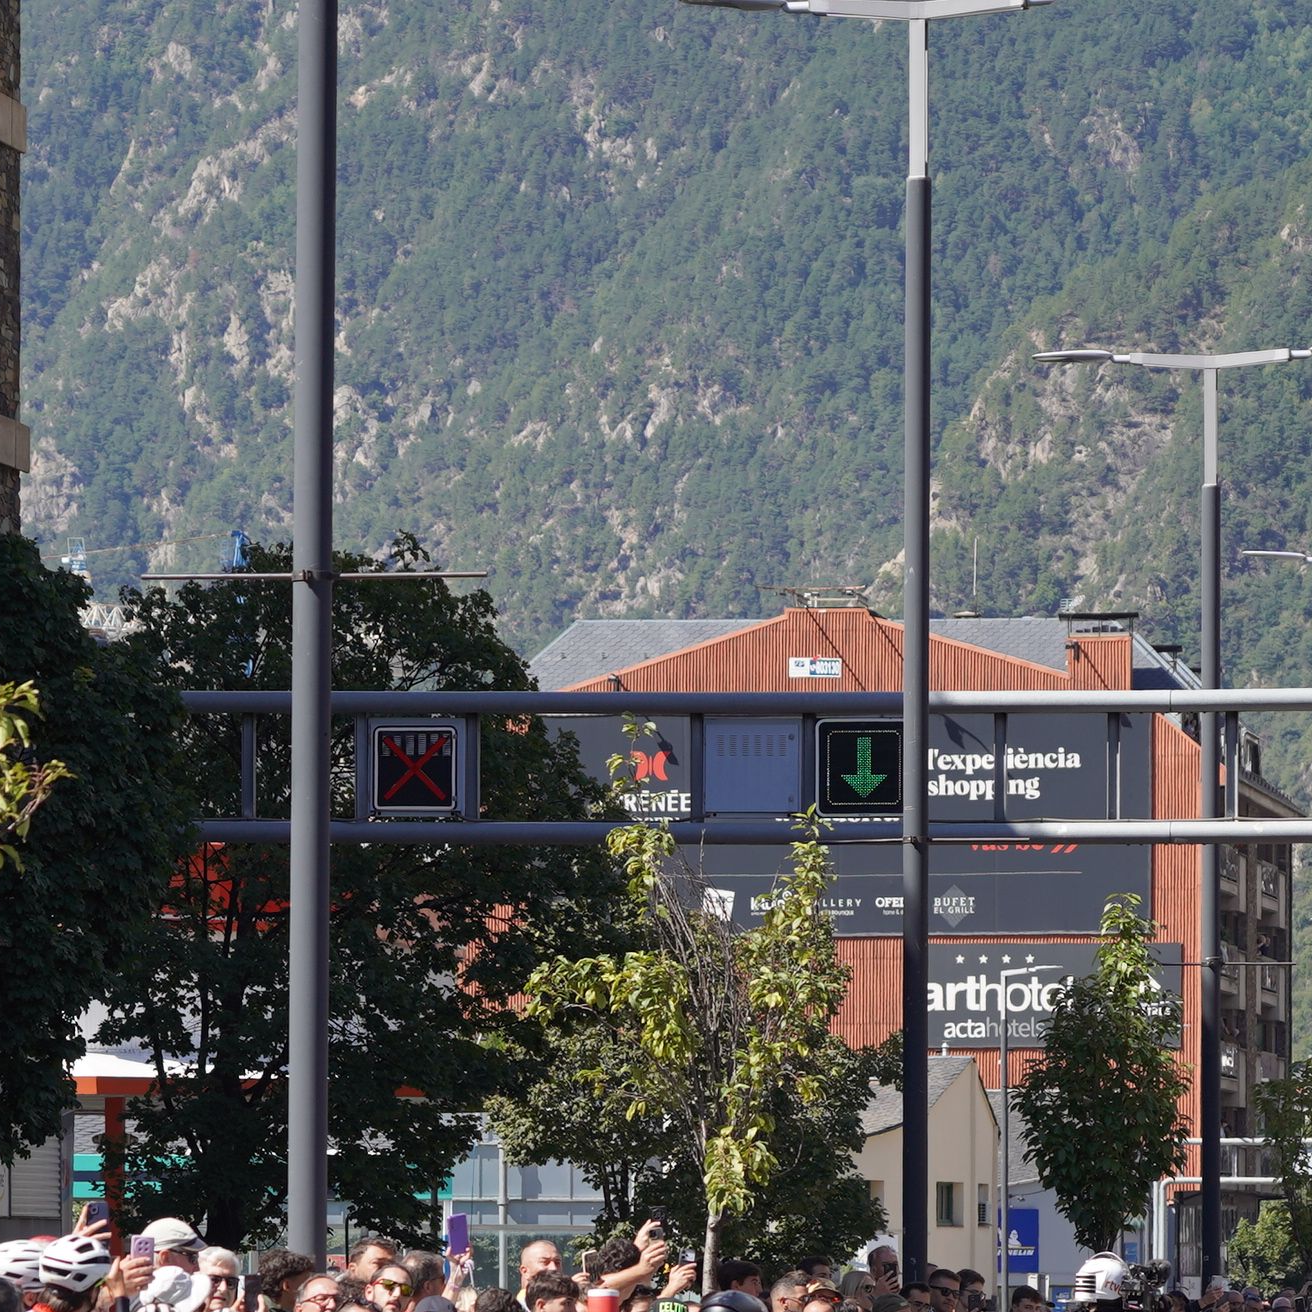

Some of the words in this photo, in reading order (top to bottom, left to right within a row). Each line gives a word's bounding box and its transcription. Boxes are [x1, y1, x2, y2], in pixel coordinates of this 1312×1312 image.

[928, 747, 1081, 774] l'expeiència
[928, 774, 1040, 800] shoppng
[933, 906, 944, 914] EL
[948, 906, 975, 914] GRILL
[934, 897, 975, 906] BUFET
